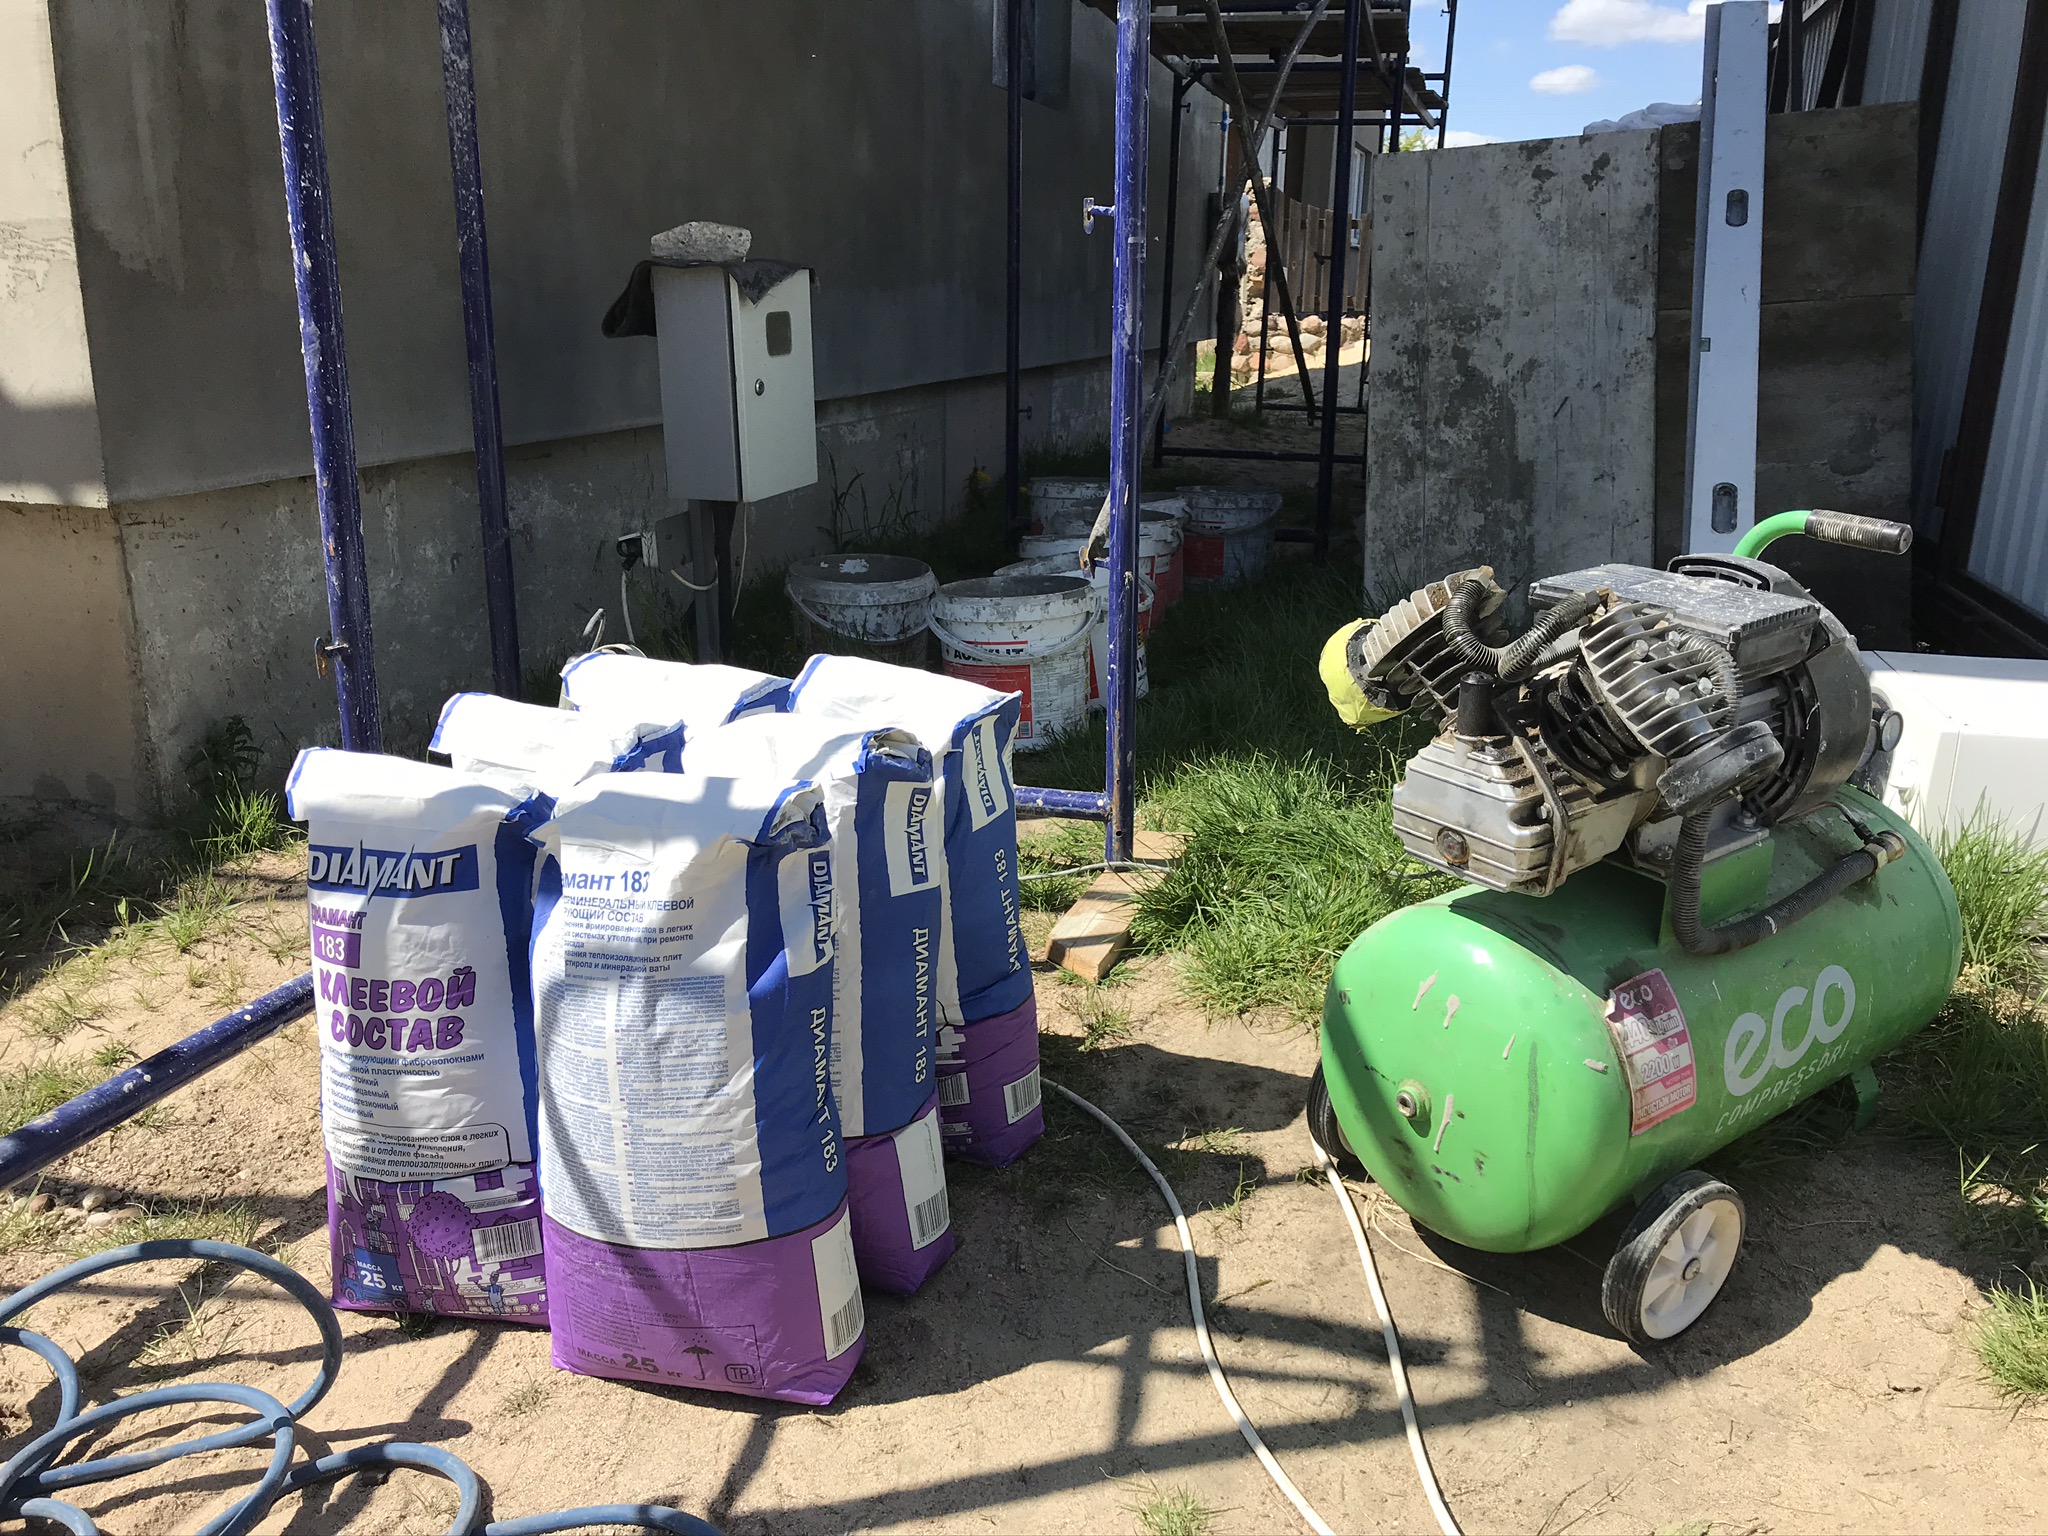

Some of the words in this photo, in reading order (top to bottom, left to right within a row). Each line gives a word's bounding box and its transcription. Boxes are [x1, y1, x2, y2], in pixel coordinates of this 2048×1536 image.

[974, 733, 993, 807] DIAMANT
[904, 794, 928, 875] DIAMANT
[309, 839, 461, 904] DIAMANT
[994, 848, 1009, 882] 183
[607, 911, 643, 923] СОСТАВ
[647, 896, 694, 912] КЛЕЕВОЙ
[643, 936, 657, 945] при
[660, 933, 694, 945] ремонте
[666, 924, 693, 934] легких
[319, 933, 346, 961] 183
[663, 953, 683, 962] плит
[649, 965, 670, 973] ваты
[913, 928, 929, 1038] ДИАМАНТ
[320, 966, 476, 1013] КЛЕЕВОЙ
[331, 1009, 464, 1052] СОСТАВ
[1724, 964, 1856, 1097] eco
[371, 1067, 440, 1077] пластичностью
[401, 1052, 485, 1067] фиброволокнами
[915, 1045, 927, 1084] 183
[1641, 1053, 1670, 1084] 2200
[1715, 1039, 1850, 1133] COMPRESSORI
[440, 1134, 460, 1142] слоя
[469, 1129, 499, 1141] легких
[377, 1147, 411, 1157] отделке
[413, 1150, 444, 1160] фасада
[387, 1157, 476, 1170] теплоизоляционных
[820, 1129, 838, 1173] 183
[357, 1261, 382, 1272] МАССА
[360, 1270, 387, 1289] 25
[391, 1284, 403, 1292] кг
[577, 1347, 618, 1366] МАССА
[622, 1353, 659, 1374] 25
[667, 1370, 683, 1379] кг
